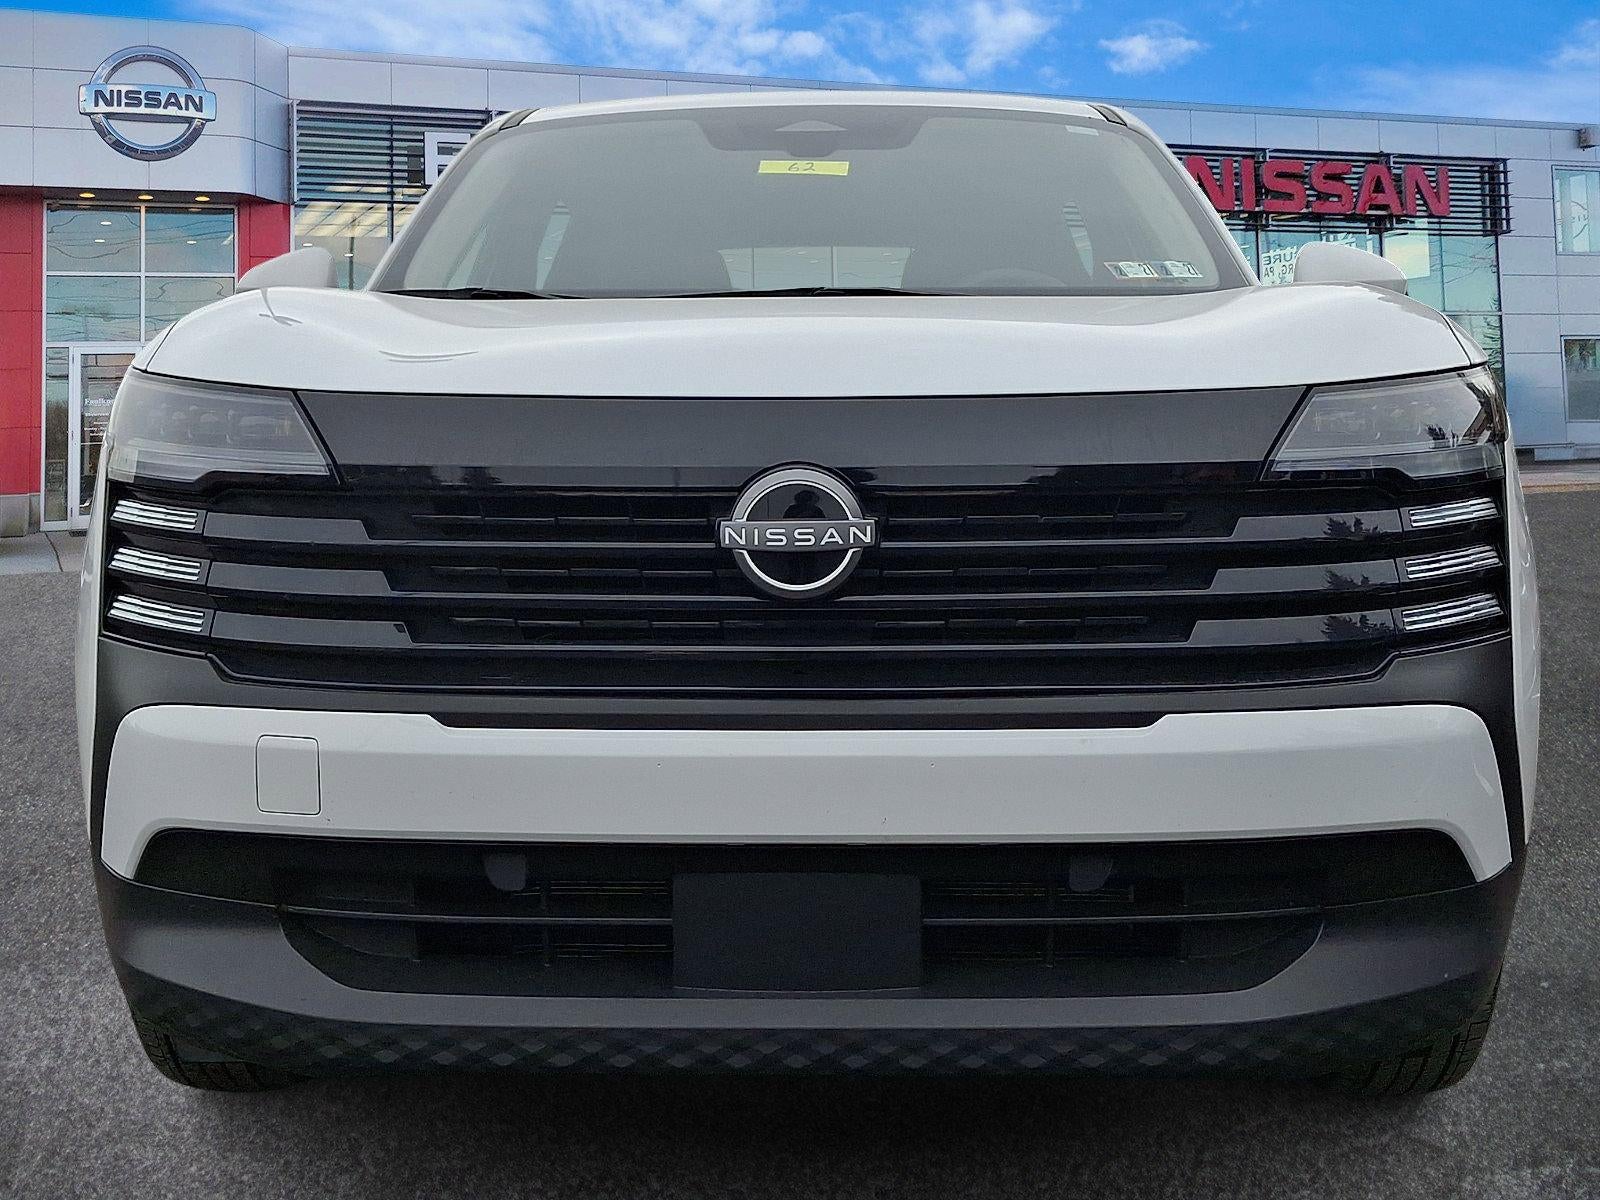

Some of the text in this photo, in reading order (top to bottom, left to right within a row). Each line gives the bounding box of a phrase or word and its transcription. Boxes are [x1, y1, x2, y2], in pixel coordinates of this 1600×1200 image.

[94, 89, 203, 113] NISSAN
[1183, 155, 1450, 216] NISSAN
[724, 525, 872, 546] NISSAN
